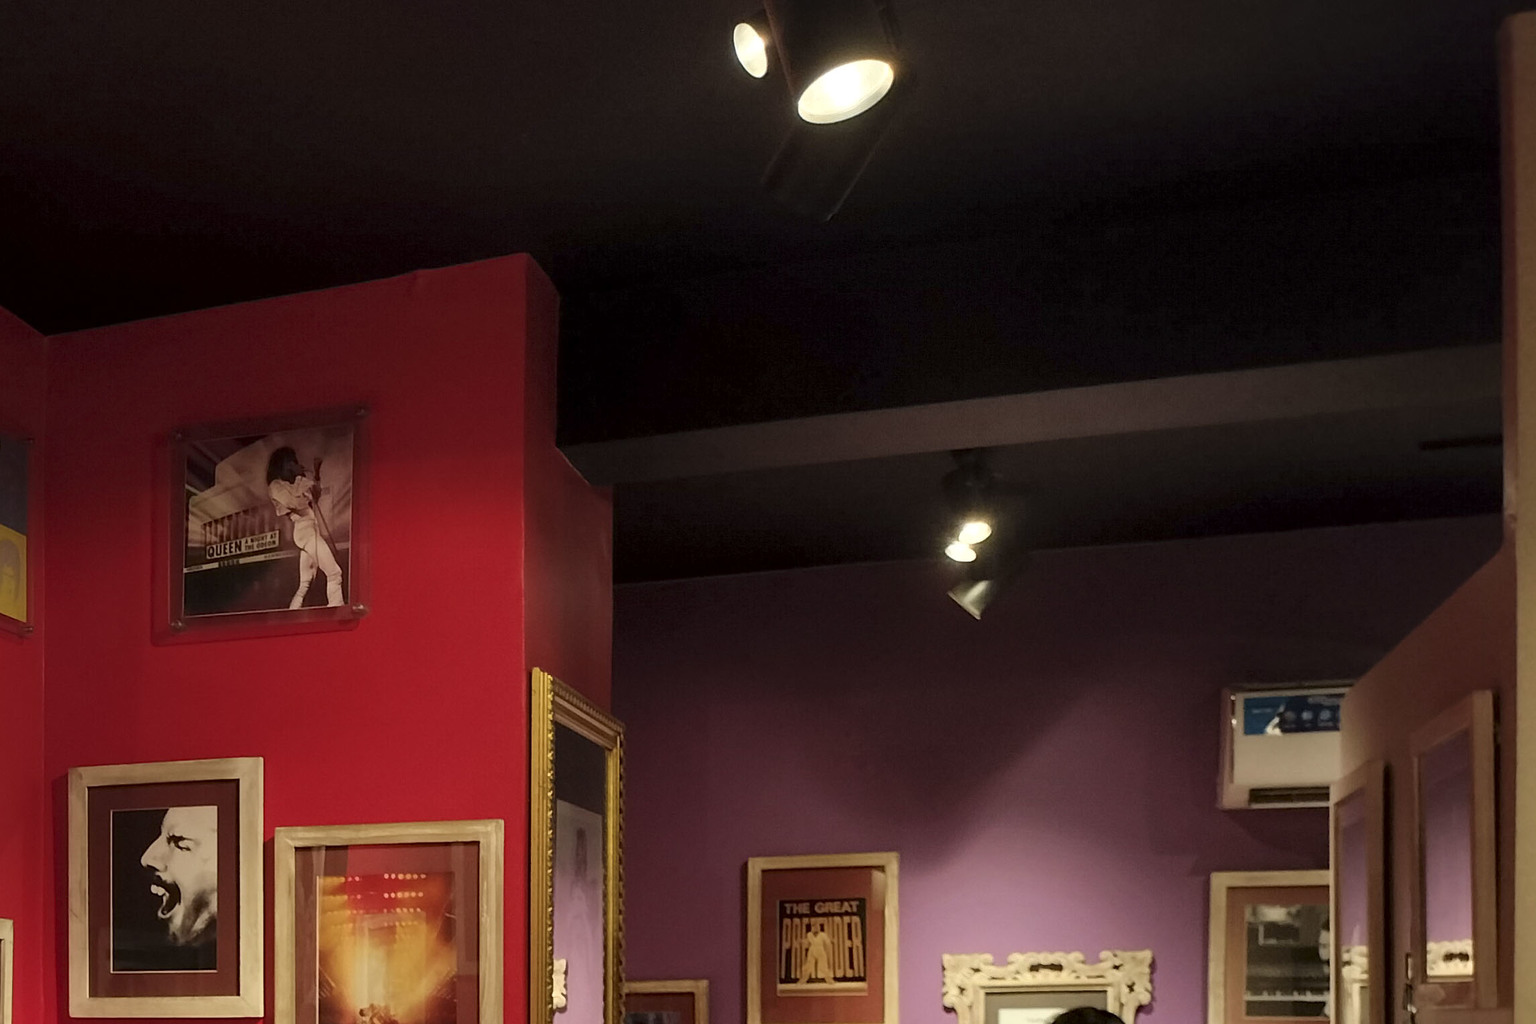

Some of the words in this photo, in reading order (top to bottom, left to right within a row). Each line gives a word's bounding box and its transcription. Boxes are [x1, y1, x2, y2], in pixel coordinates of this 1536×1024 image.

[207, 540, 242, 557] QUEEN
[784, 902, 810, 914] THE
[814, 901, 860, 914] GREAT
[781, 916, 864, 979] PRENDER
